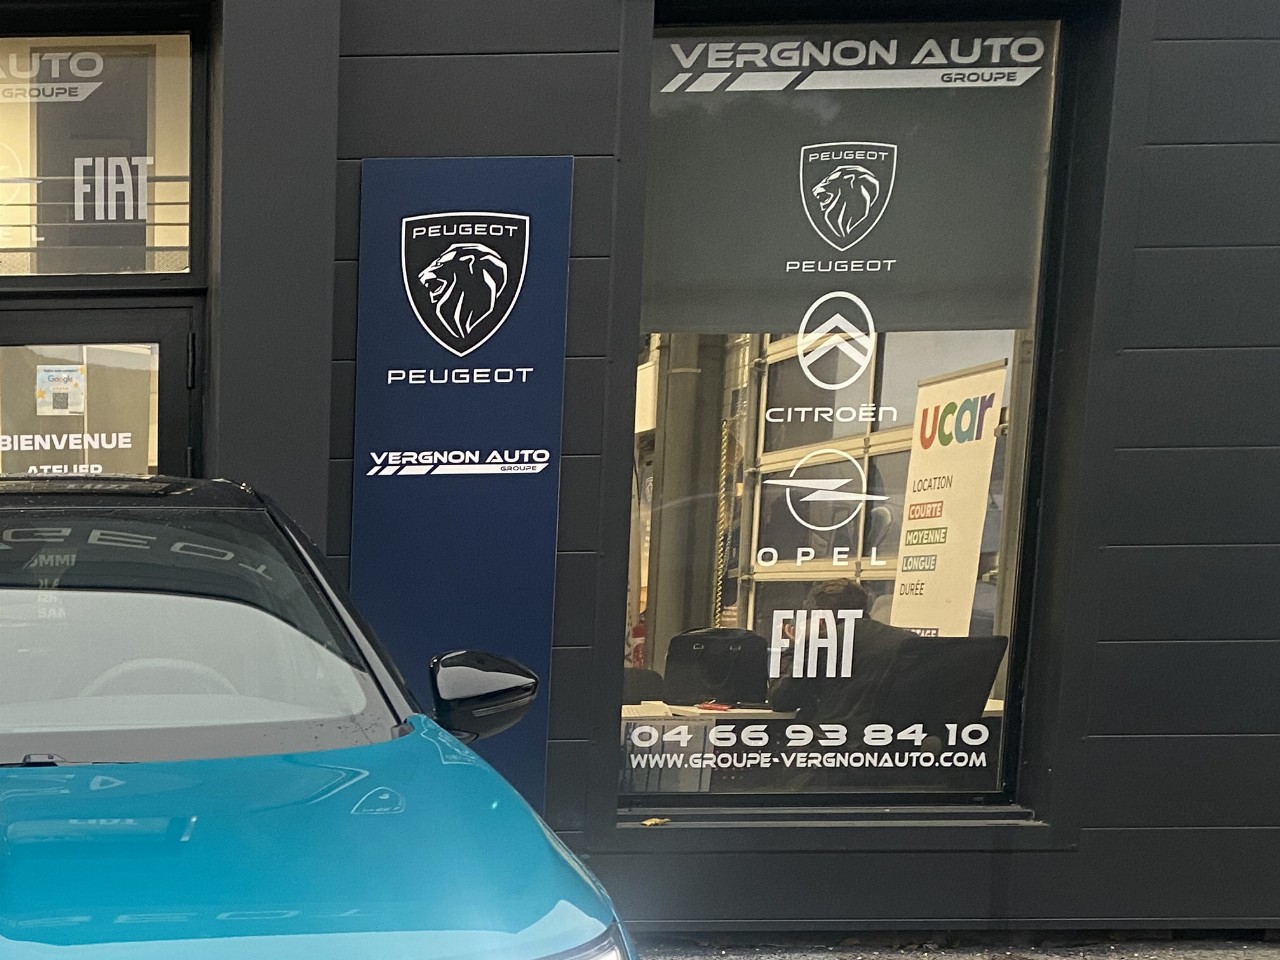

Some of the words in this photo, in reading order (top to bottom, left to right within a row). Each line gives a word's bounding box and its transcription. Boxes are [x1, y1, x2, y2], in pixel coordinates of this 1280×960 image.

[670, 39, 897, 69] VERGNON
[911, 37, 1045, 65] AUTO
[940, 71, 1018, 84] GROUPE
[1, 85, 79, 99] GROUPE
[808, 150, 889, 162] PEUGEOT
[74, 156, 155, 221] FIAT
[412, 223, 519, 239] PEUGEOT
[785, 259, 897, 273] PEUGEOT
[387, 367, 534, 385] PEUGEOT
[765, 403, 898, 423] CITROËN
[919, 392, 996, 450] ucar
[369, 450, 480, 465] VERGNON
[484, 449, 551, 464] AUTO
[912, 475, 954, 493] LOCATION
[909, 503, 943, 519] COURTE
[906, 528, 947, 545] MOYENNE
[757, 547, 887, 567] OPEL
[902, 556, 937, 570] LONGUE
[900, 579, 925, 596] DURÉE
[769, 609, 864, 679] FIAT
[631, 724, 694, 748] 04
[708, 724, 770, 747] 66
[786, 724, 848, 747] 93
[863, 723, 928, 747] 84
[945, 722, 990, 746] 10
[630, 751, 988, 769] WWW.GROUPE-VERGNONAUTO.COM
